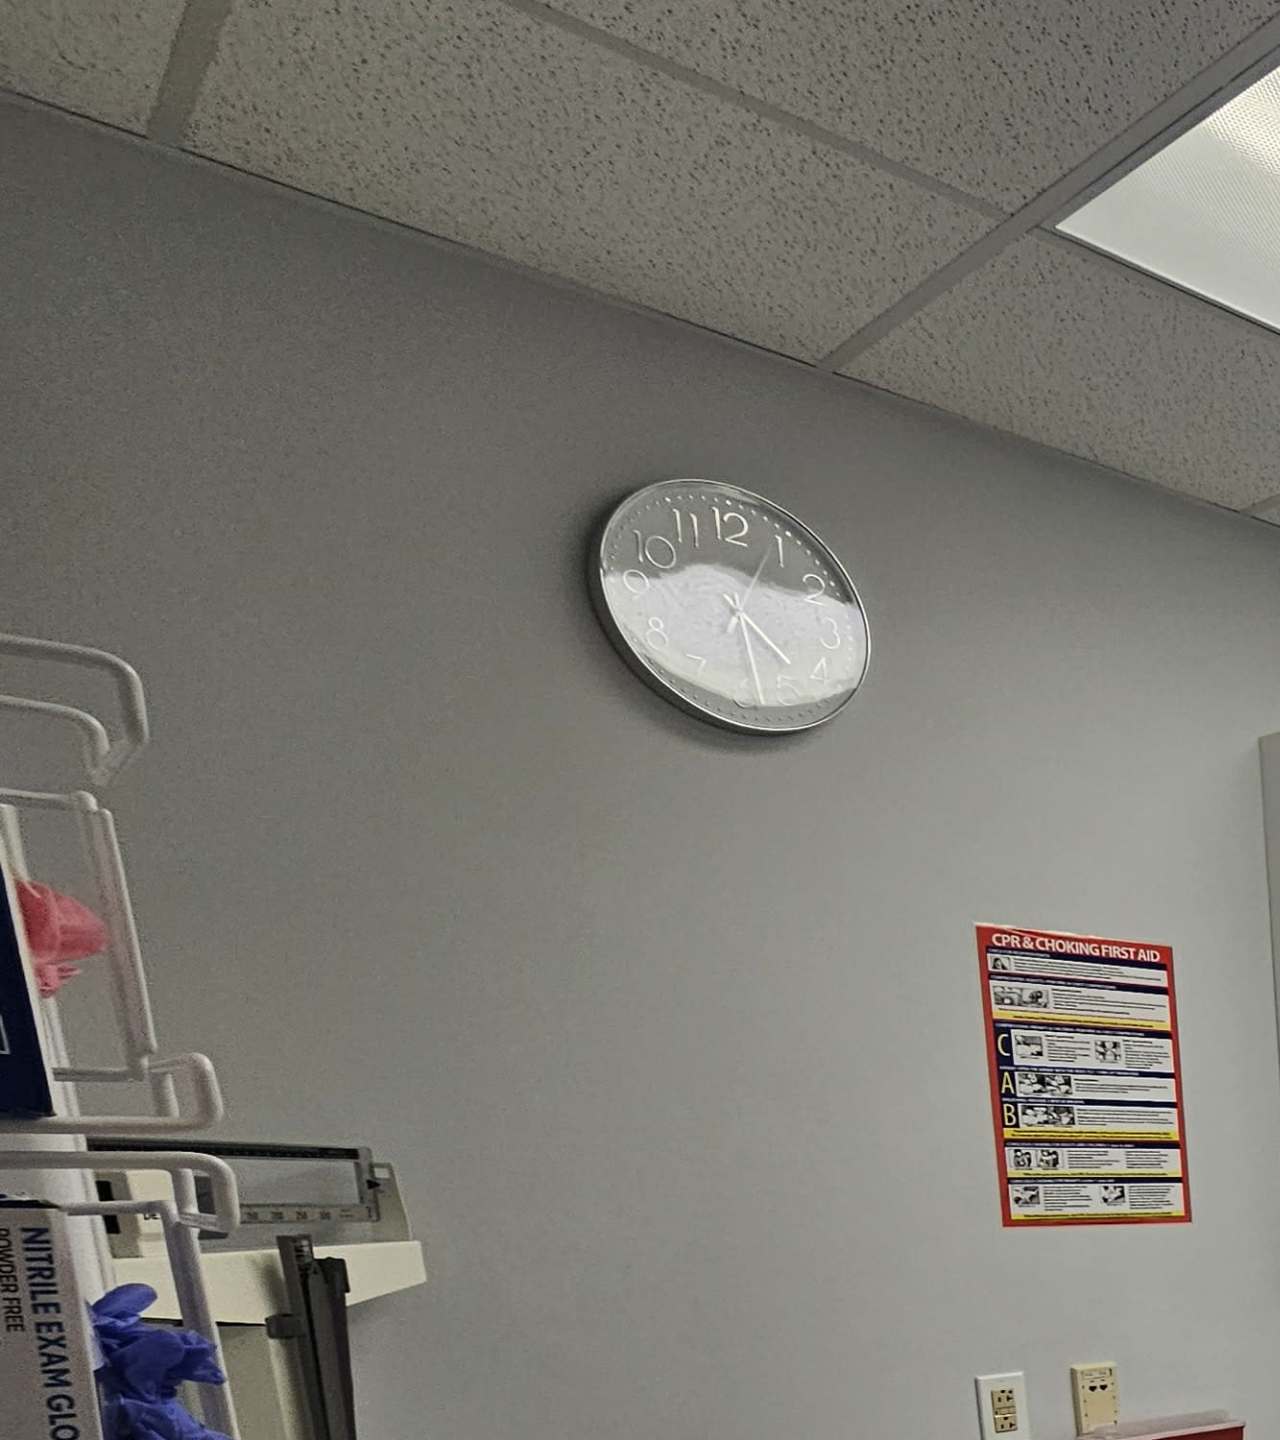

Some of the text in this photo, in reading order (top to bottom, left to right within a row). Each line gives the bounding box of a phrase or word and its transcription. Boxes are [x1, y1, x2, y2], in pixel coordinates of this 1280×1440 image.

[672, 508, 699, 548] 11
[711, 506, 748, 547] 12
[632, 529, 677, 569] 10
[774, 535, 785, 568] 1
[622, 569, 651, 600] 9
[802, 573, 827, 606] 2
[645, 616, 669, 651] 8
[820, 616, 842, 650] 3
[686, 653, 707, 675] 7
[810, 656, 830, 682] 4
[776, 674, 801, 706] 5
[991, 933, 1022, 949] CPR
[1023, 938, 1034, 950] &
[1035, 938, 1100, 956] CHOKING
[1101, 944, 1136, 960] FIRST
[1137, 949, 1161, 962] AID
[997, 1033, 1011, 1056] C
[1001, 1071, 1015, 1094] A
[1003, 1103, 1017, 1126] B
[0, 1228, 25, 1333] POWDER FREE
[20, 1227, 62, 1315] NITRILE
[35, 1321, 73, 1388] EXAM
